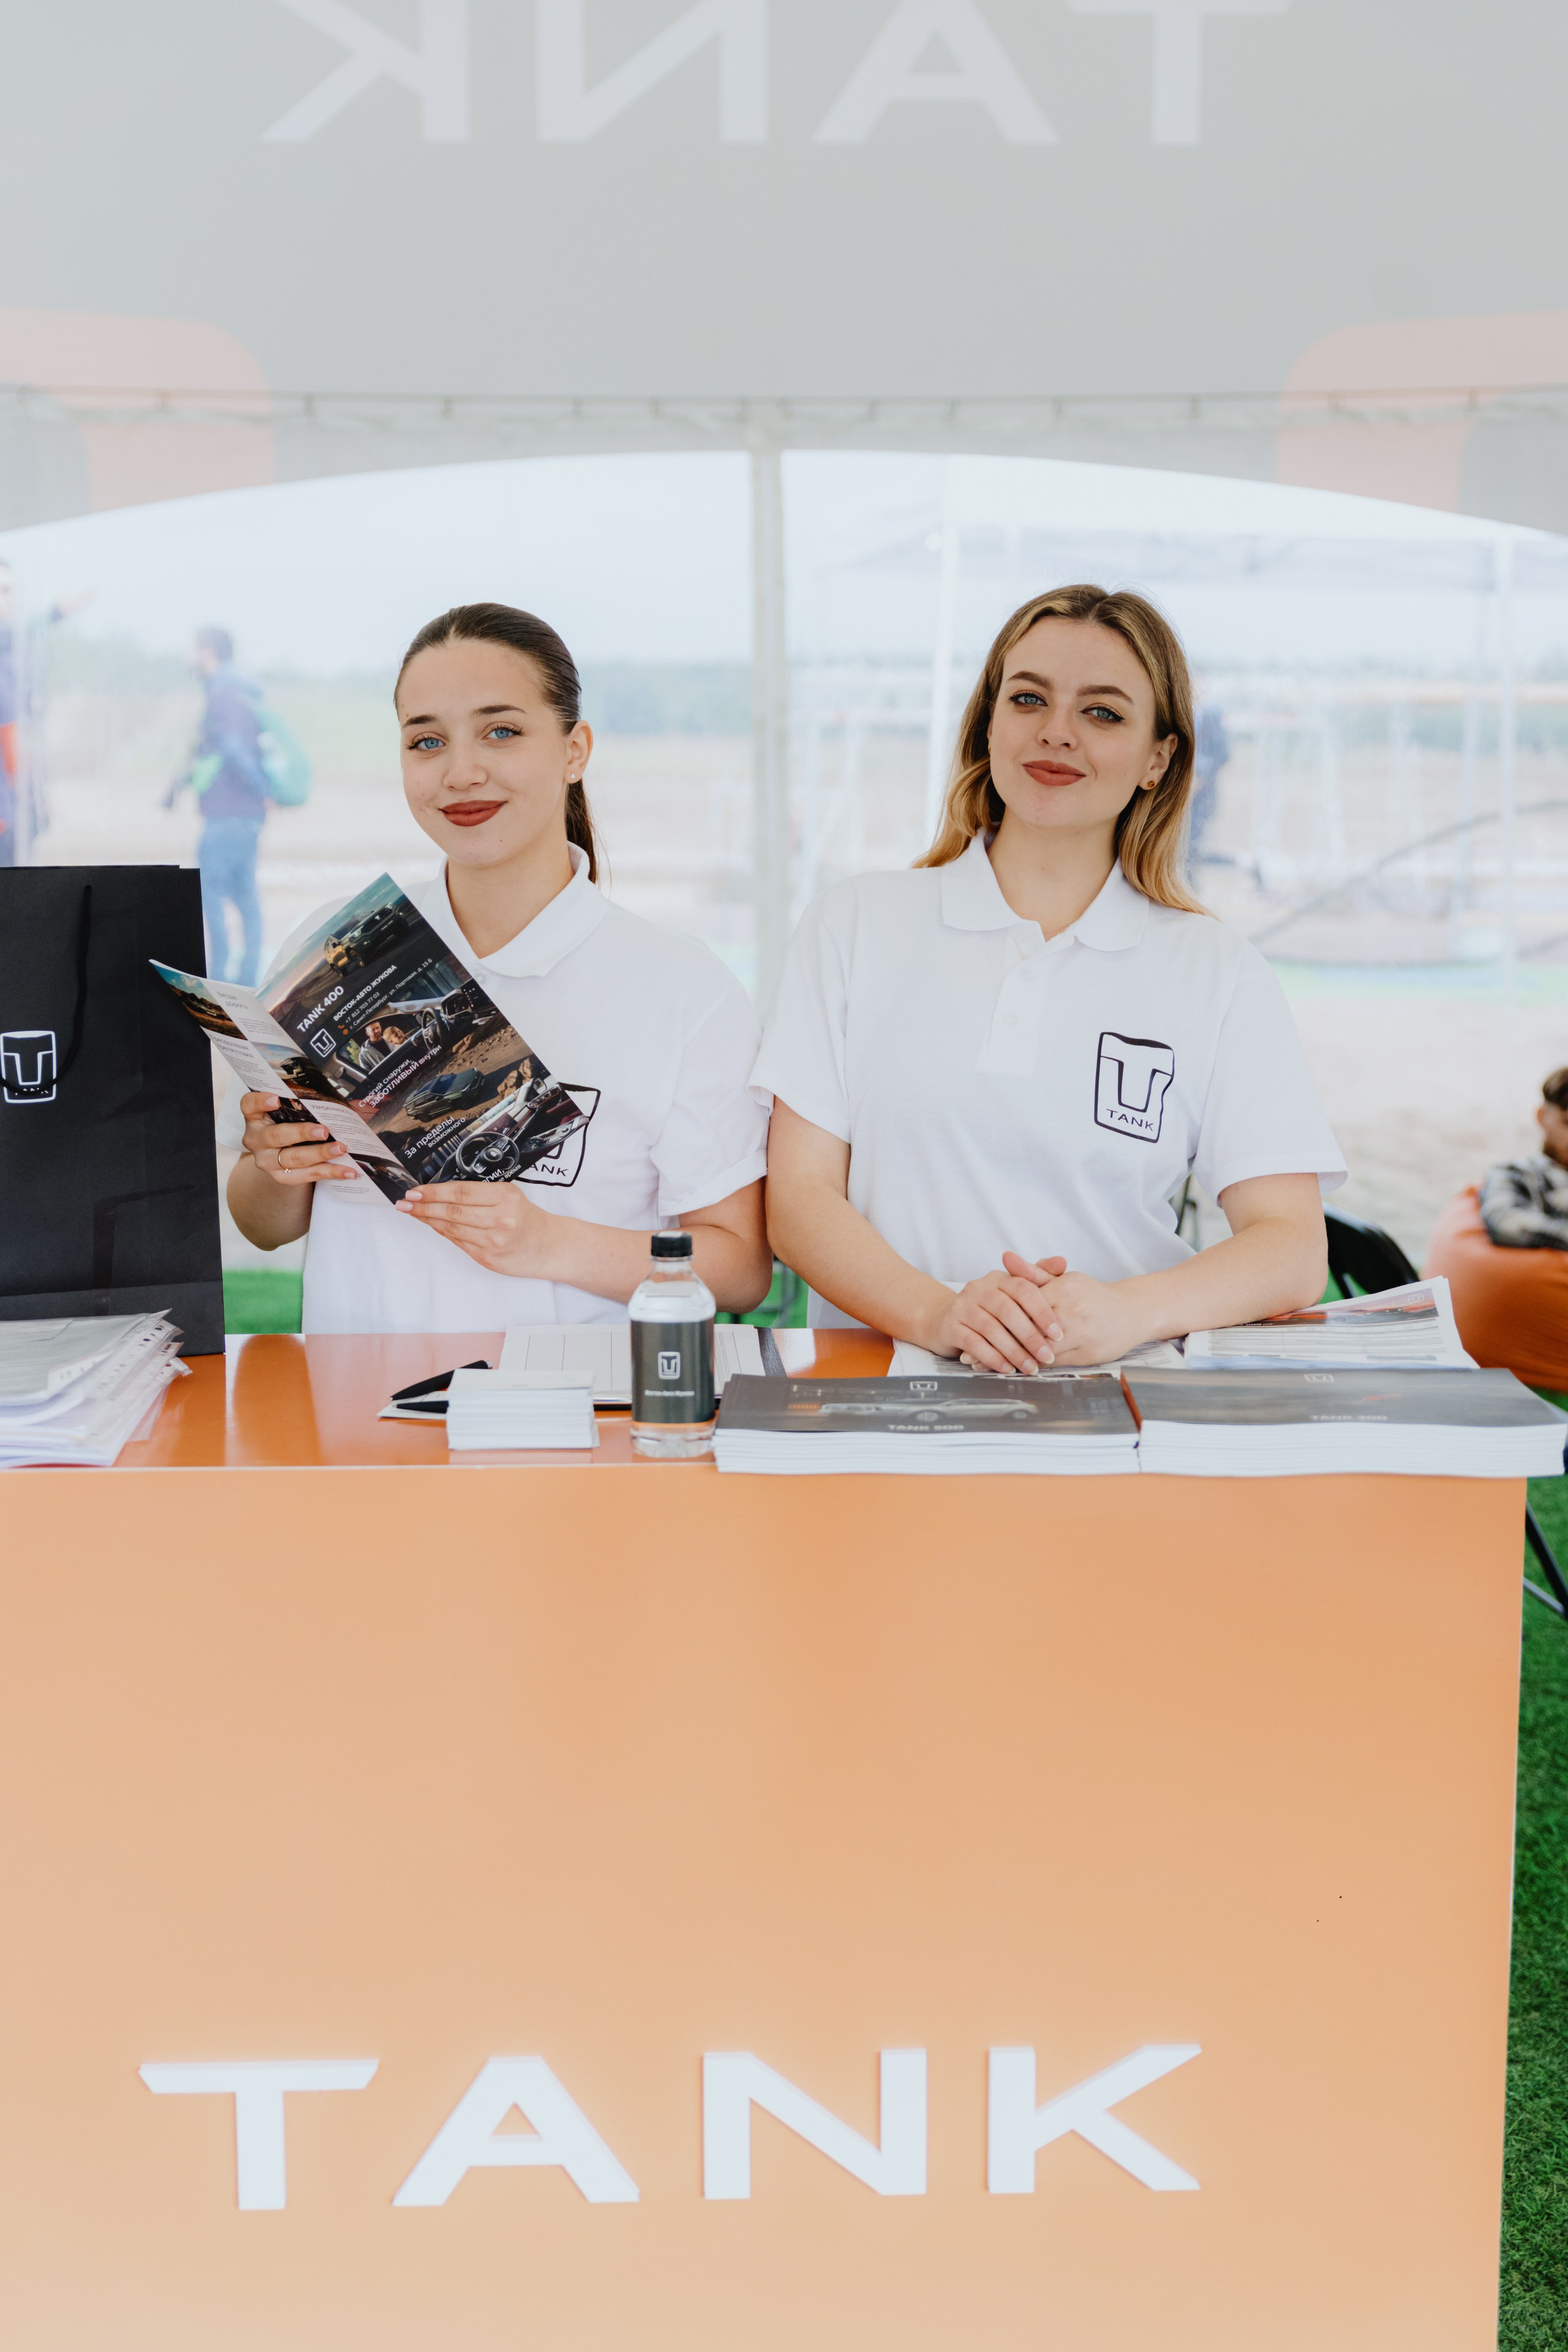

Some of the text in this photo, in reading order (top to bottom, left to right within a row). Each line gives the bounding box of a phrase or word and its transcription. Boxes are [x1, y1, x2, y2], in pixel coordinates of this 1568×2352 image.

[333, 965, 397, 1022] ВОСТОК-АВТО ЖУКОВА
[353, 993, 390, 1026] Санкт-Петербург,
[395, 971, 418, 989] Портовая,
[368, 997, 374, 1006] 77
[296, 1004, 325, 1033] TANK
[324, 986, 344, 1006] 400
[323, 1044, 333, 1054] TANK
[419, 1044, 442, 1065] внутри
[359, 1058, 412, 1107] Строгий снаружи,
[428, 1117, 466, 1148] возможного
[1106, 1108, 1154, 1131] TANK
[404, 1117, 454, 1158] За пределы
[505, 1164, 521, 1178] время
[530, 1163, 568, 1177] ANK
[138, 2044, 1201, 2211] TANK
